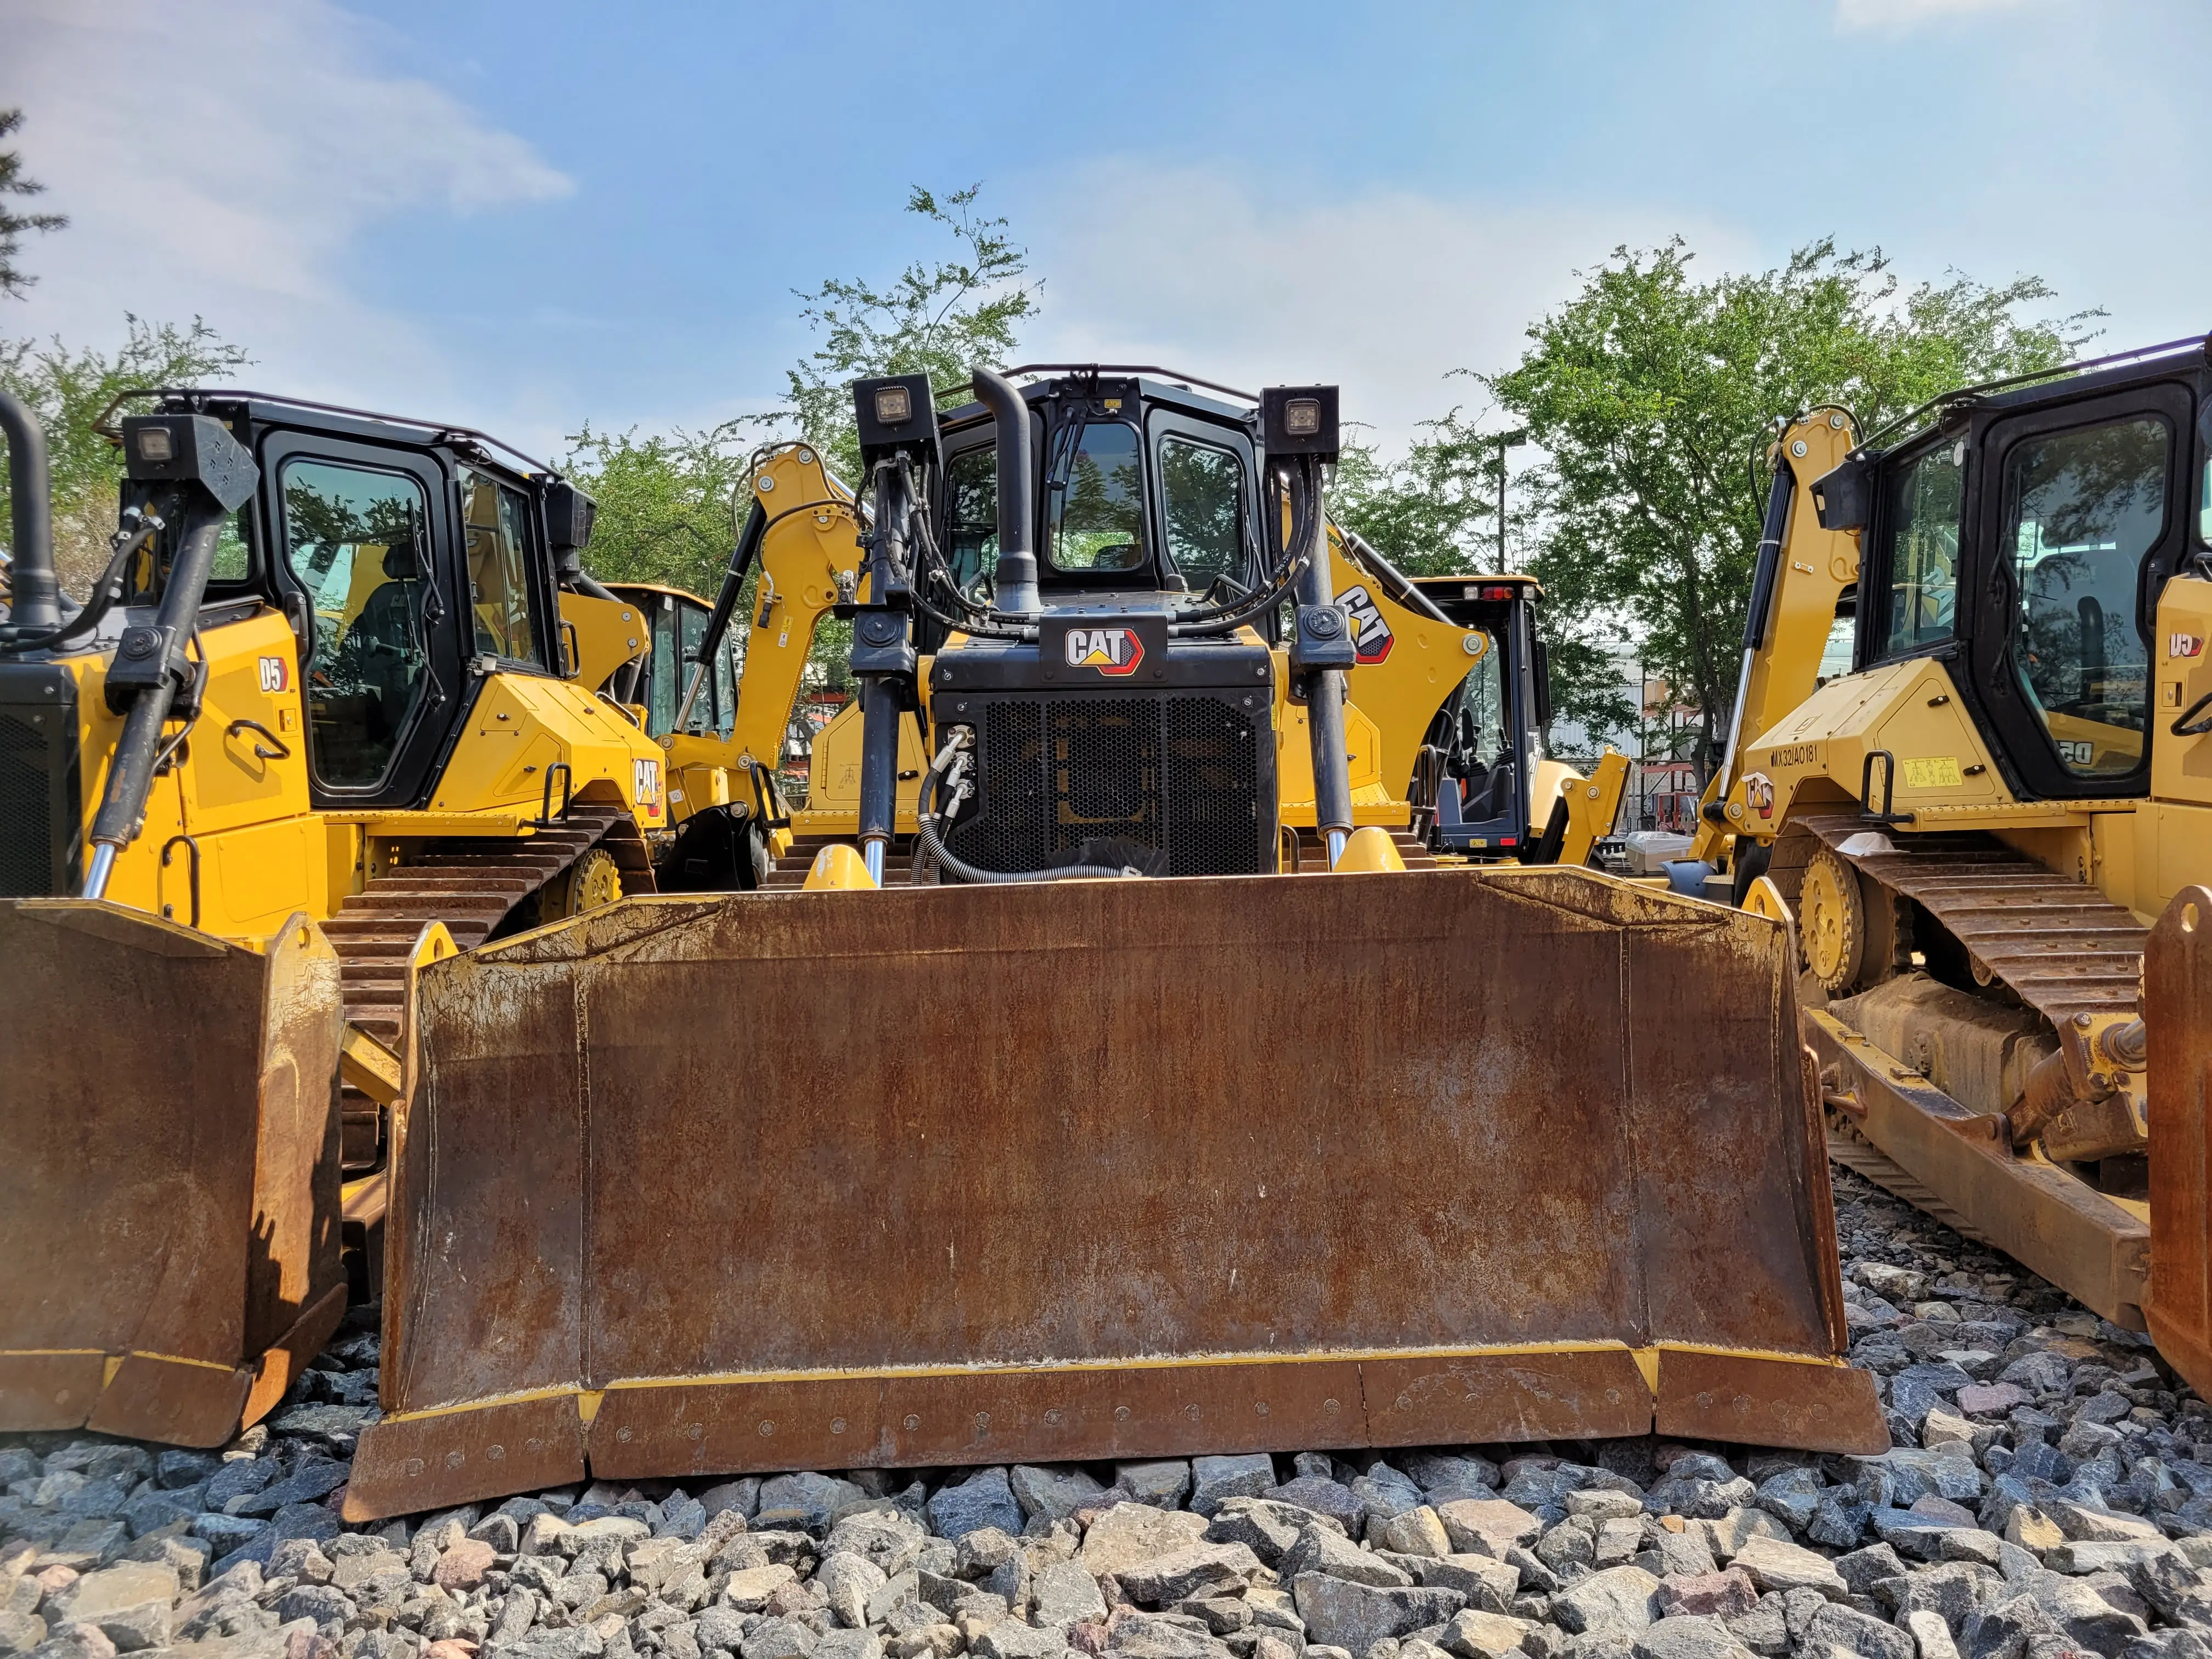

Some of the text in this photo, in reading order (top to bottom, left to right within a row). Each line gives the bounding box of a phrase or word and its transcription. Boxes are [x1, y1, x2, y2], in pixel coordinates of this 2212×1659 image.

[1335, 586, 1391, 647] CAT
[1068, 630, 1125, 665] CAT
[259, 658, 280, 690] D5
[636, 760, 657, 804] CAT
